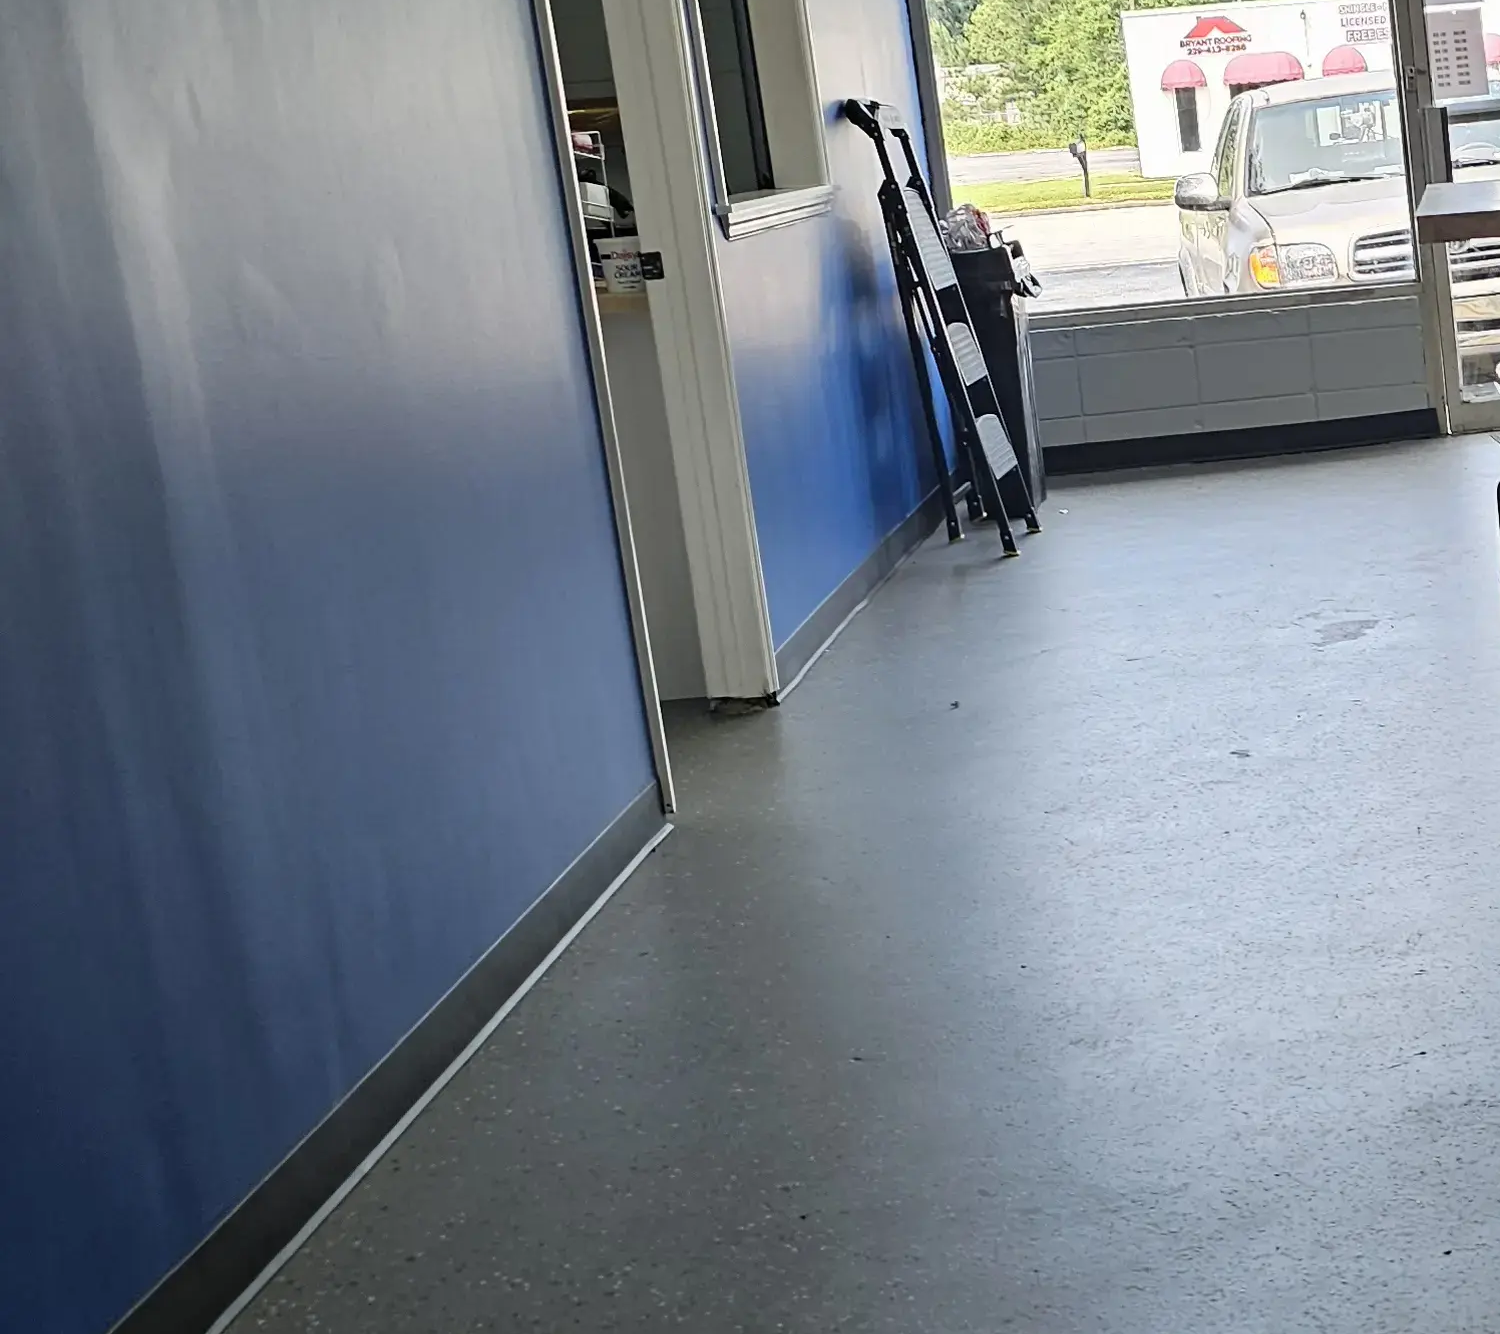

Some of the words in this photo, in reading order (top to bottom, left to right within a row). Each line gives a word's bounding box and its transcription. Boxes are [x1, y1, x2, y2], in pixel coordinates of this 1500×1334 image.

[1340, 15, 1387, 28] LICENSED
[1180, 37, 1212, 48] BRYANT
[1214, 34, 1252, 46] ROOFING
[1346, 28, 1376, 42] FREE
